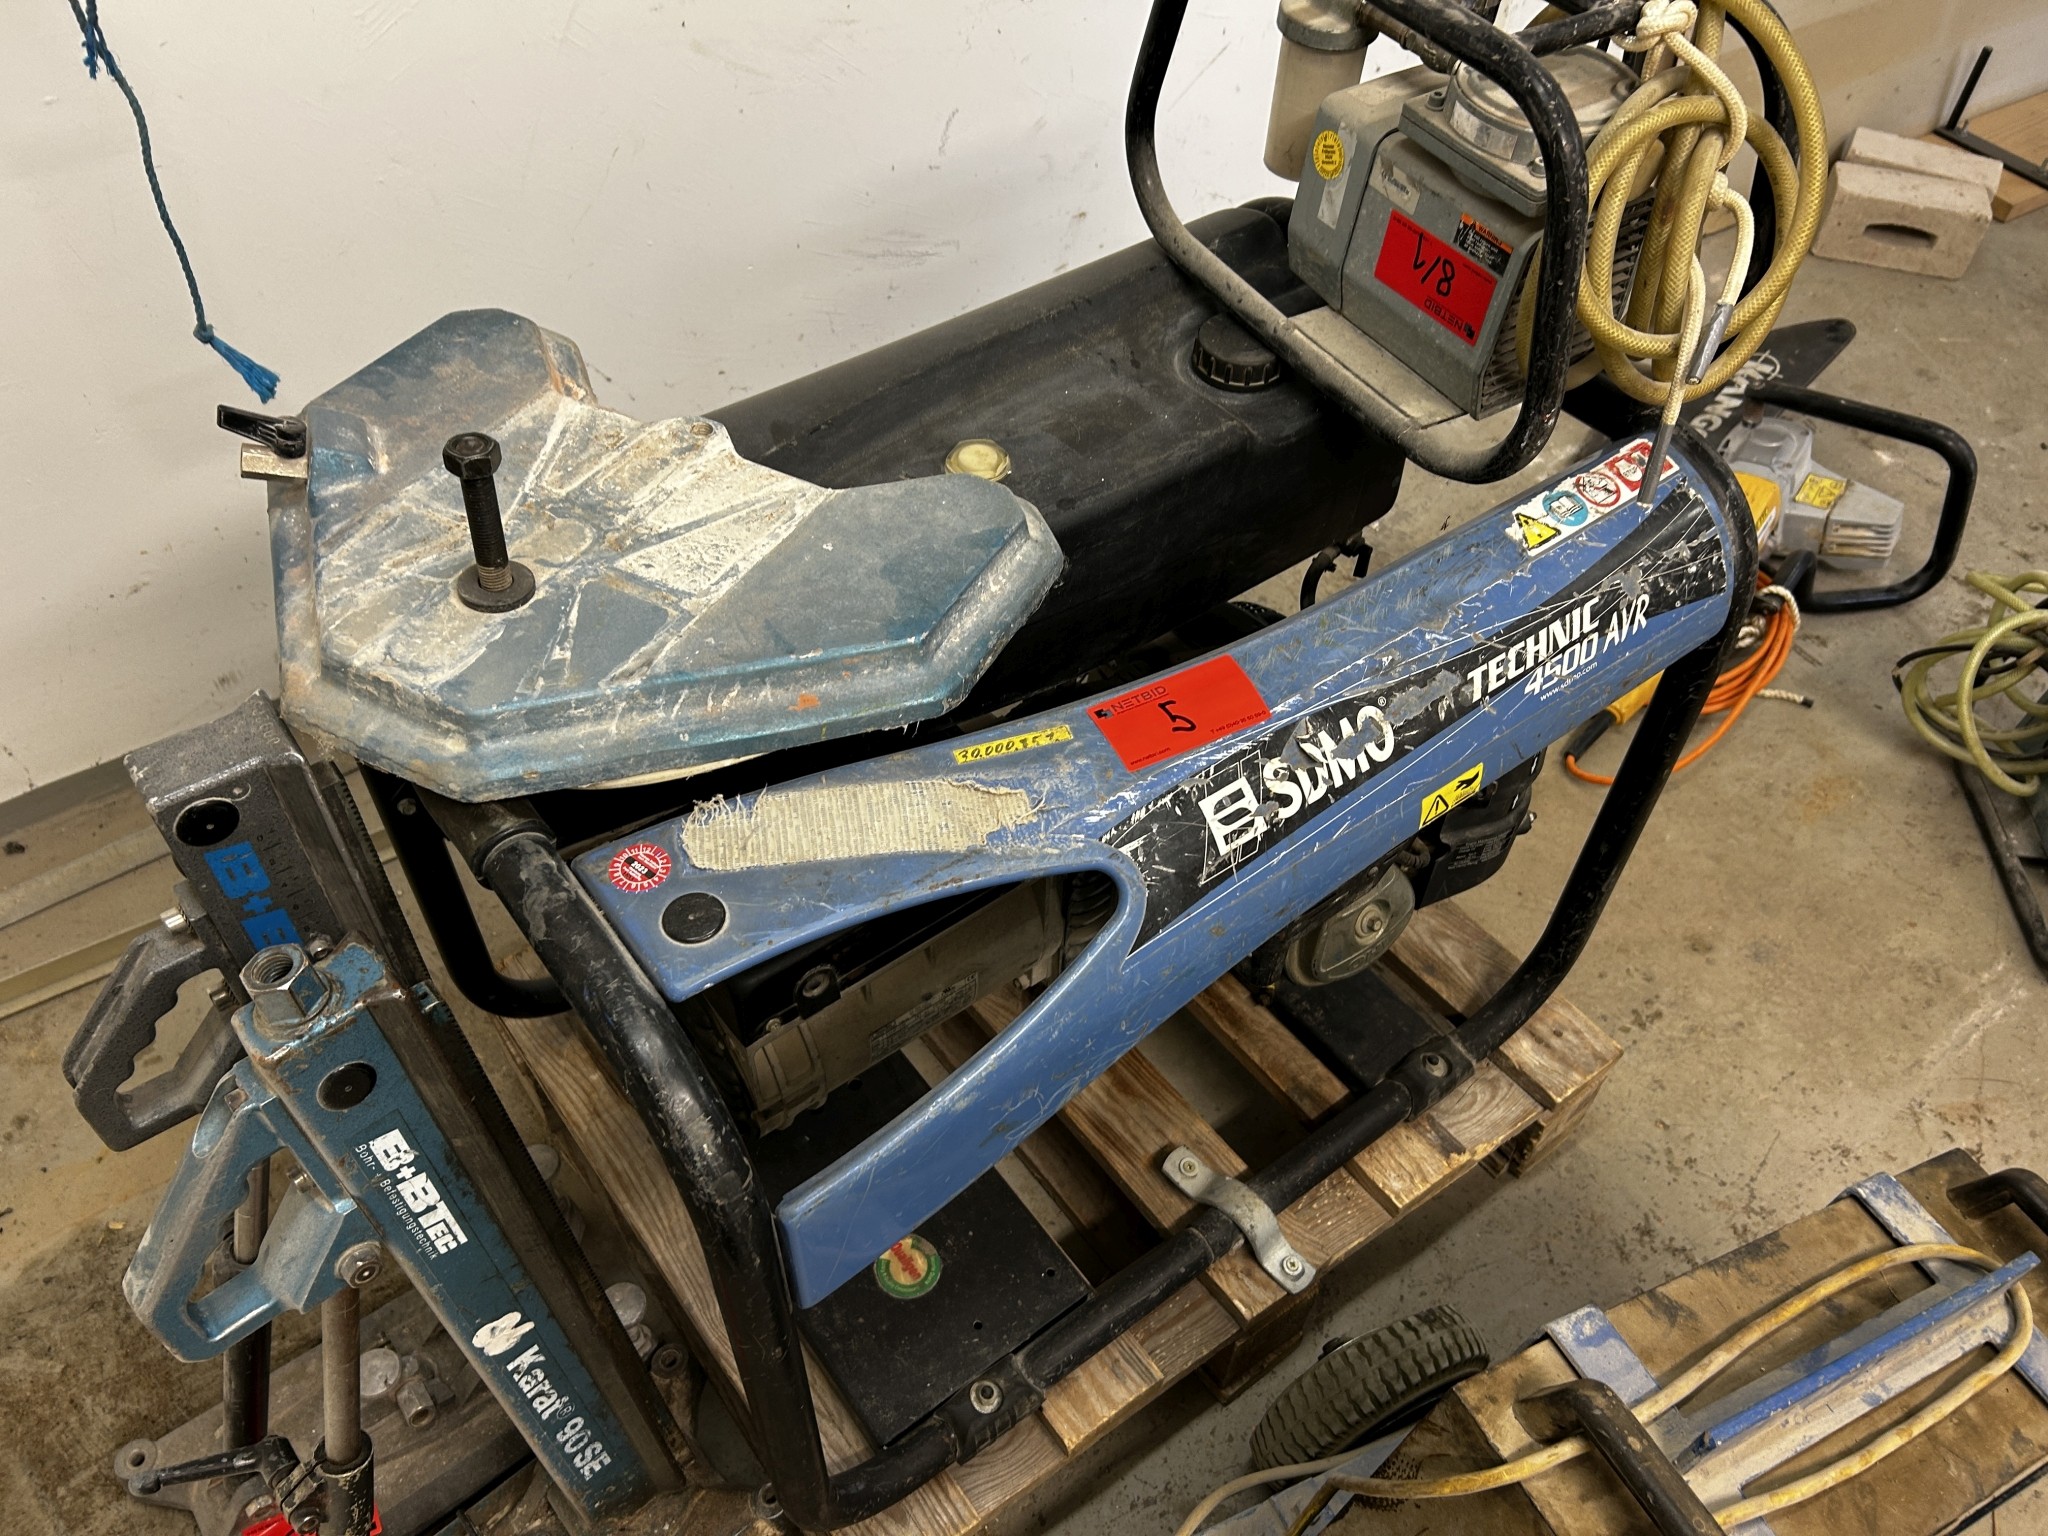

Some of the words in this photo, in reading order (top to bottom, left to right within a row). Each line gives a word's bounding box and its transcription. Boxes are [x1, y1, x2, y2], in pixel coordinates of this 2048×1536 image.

[1424, 297, 1464, 332] NETBID
[1467, 596, 1599, 703] TECHNIC
[1524, 632, 1599, 696] 4500
[1603, 593, 1650, 654] AVR
[1111, 685, 1167, 713] NETBID
[1157, 700, 1197, 732] 5
[354, 1143, 376, 1170] Bohr-
[380, 1178, 440, 1261] Befestigungstechnik
